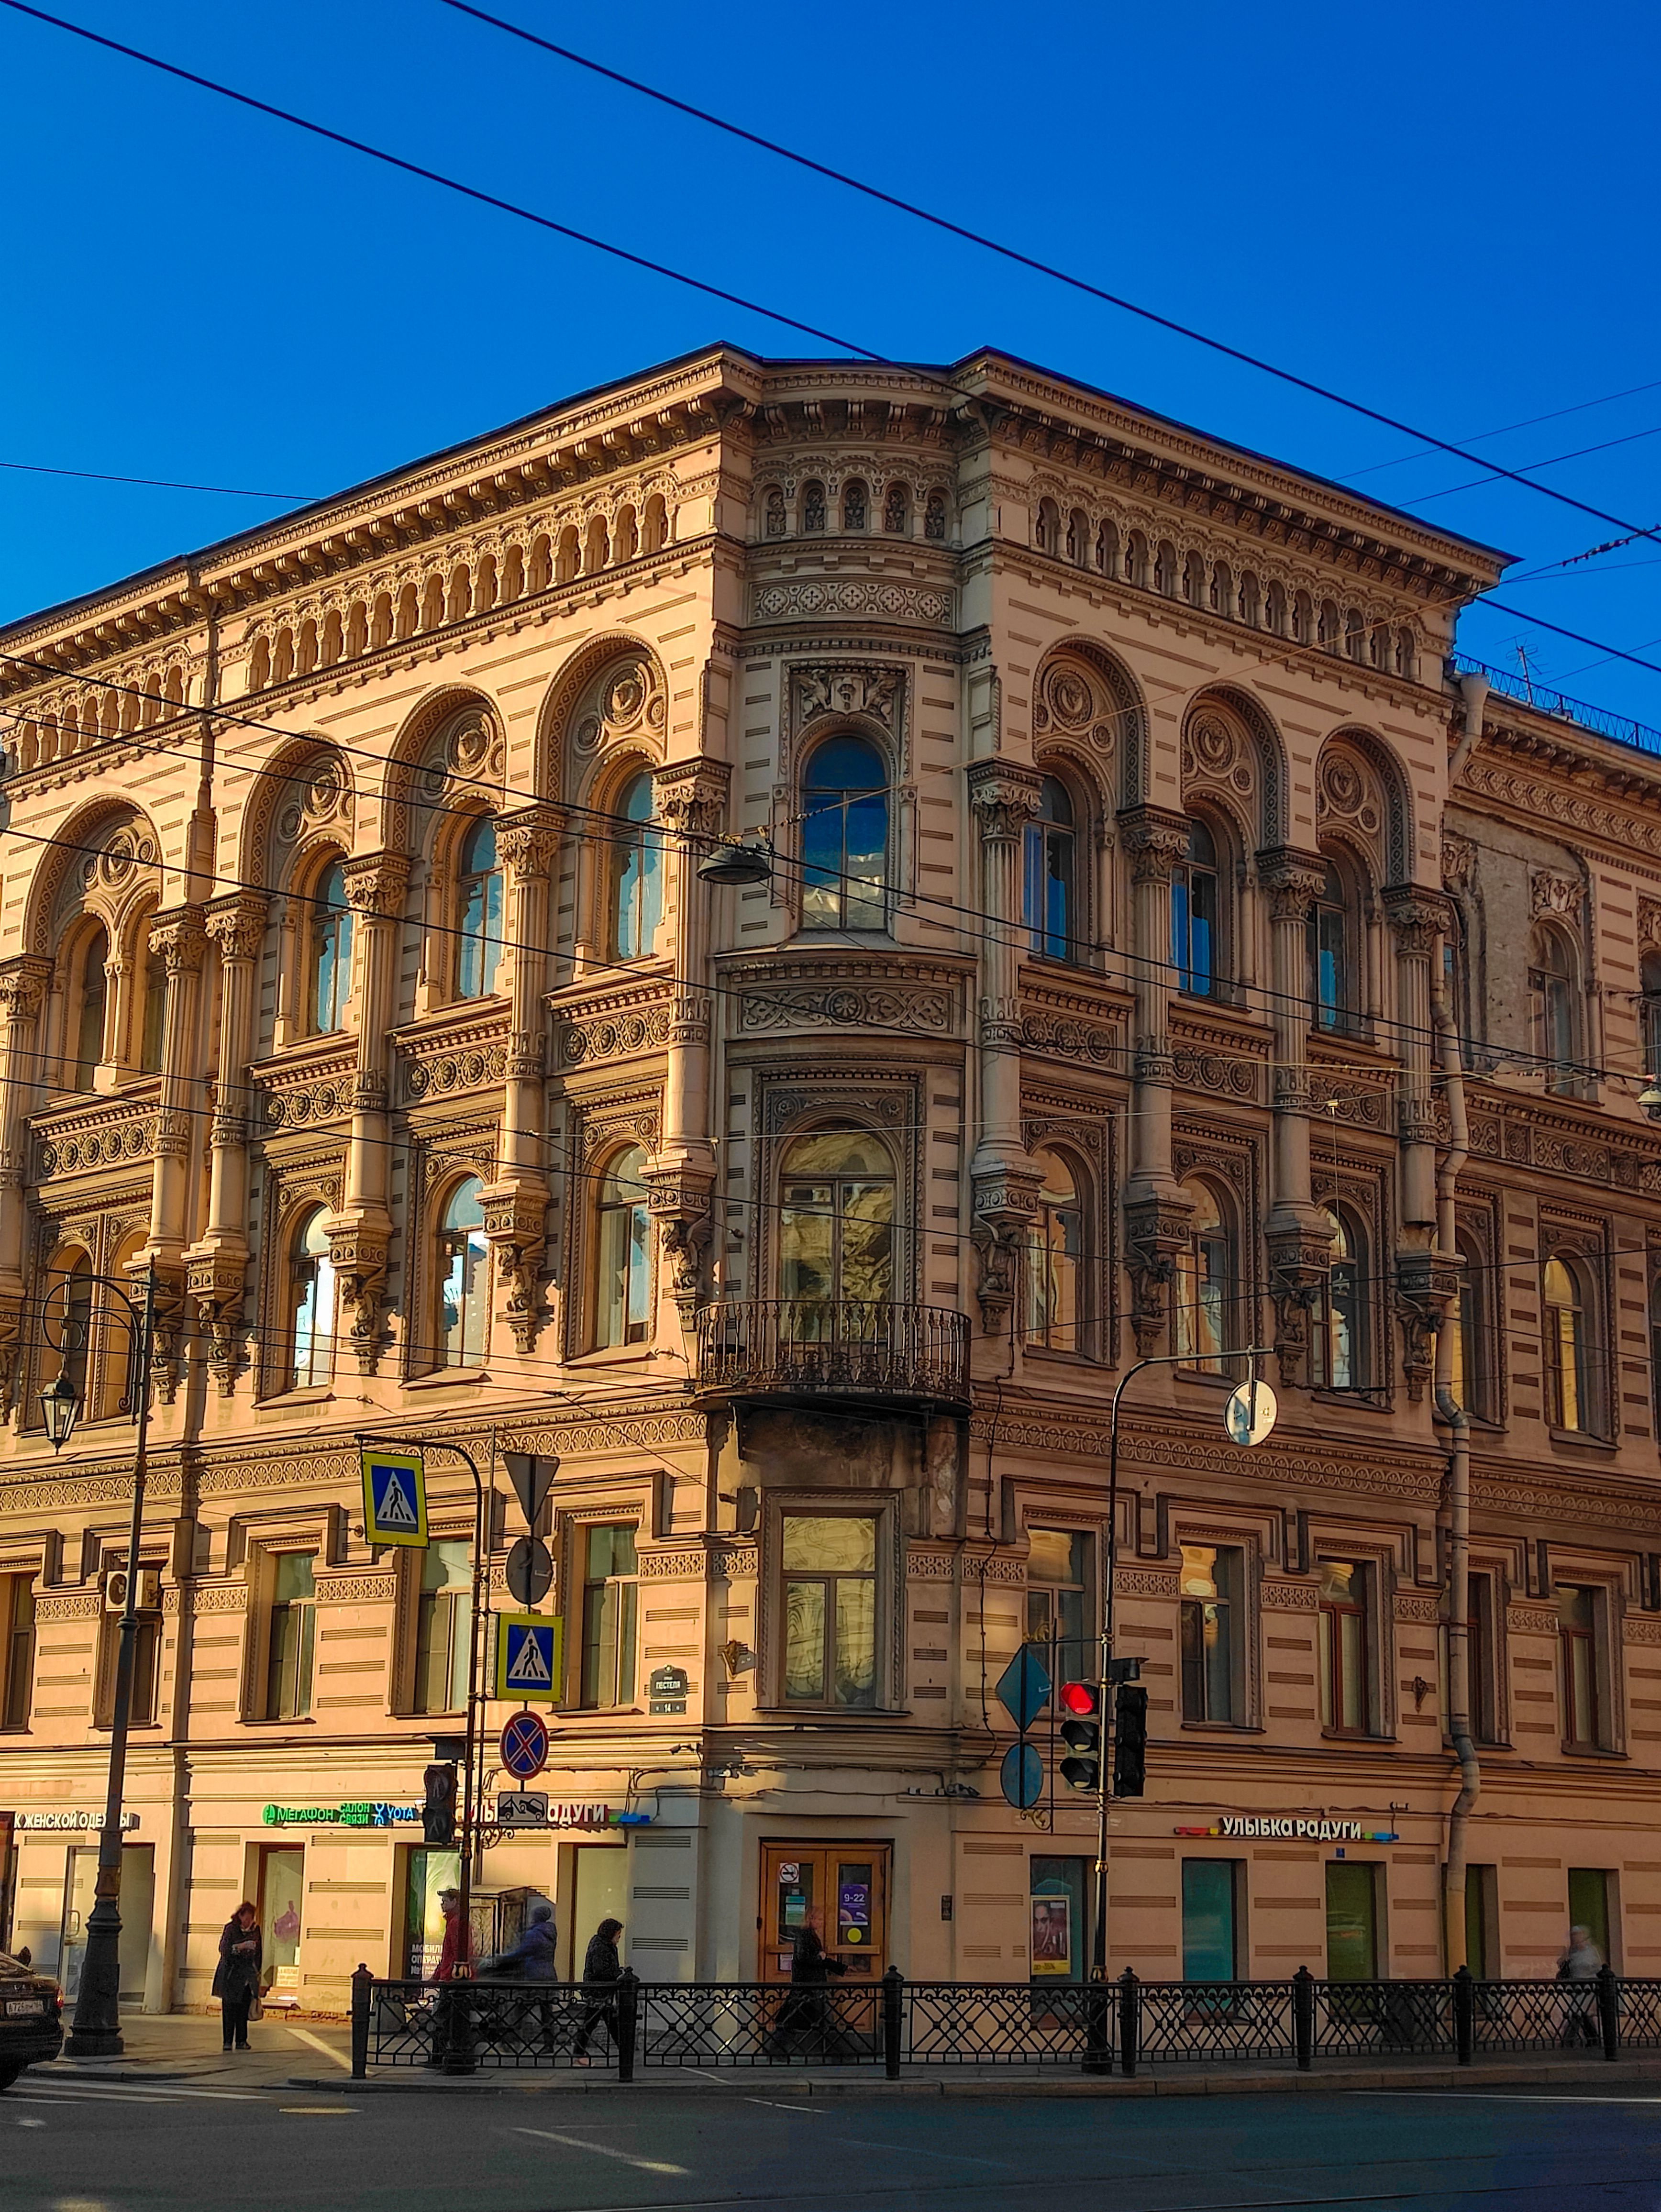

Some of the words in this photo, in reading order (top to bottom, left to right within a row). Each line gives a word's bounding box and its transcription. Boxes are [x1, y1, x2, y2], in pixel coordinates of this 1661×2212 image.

[655, 1681, 681, 1690] ПЕСТЕЛЯ
[664, 1703, 671, 1712] 14
[339, 1803, 370, 1813] САЛОН
[388, 1807, 414, 1819] YOTA
[277, 1807, 334, 1821] МЕГАФОН
[23, 1810, 78, 1828] ЖЕНСКОЙ
[78, 1813, 130, 1830] ОДЕЫ
[339, 1814, 369, 1825] СВЯЗИ
[844, 1893, 865, 1902] 9-22
